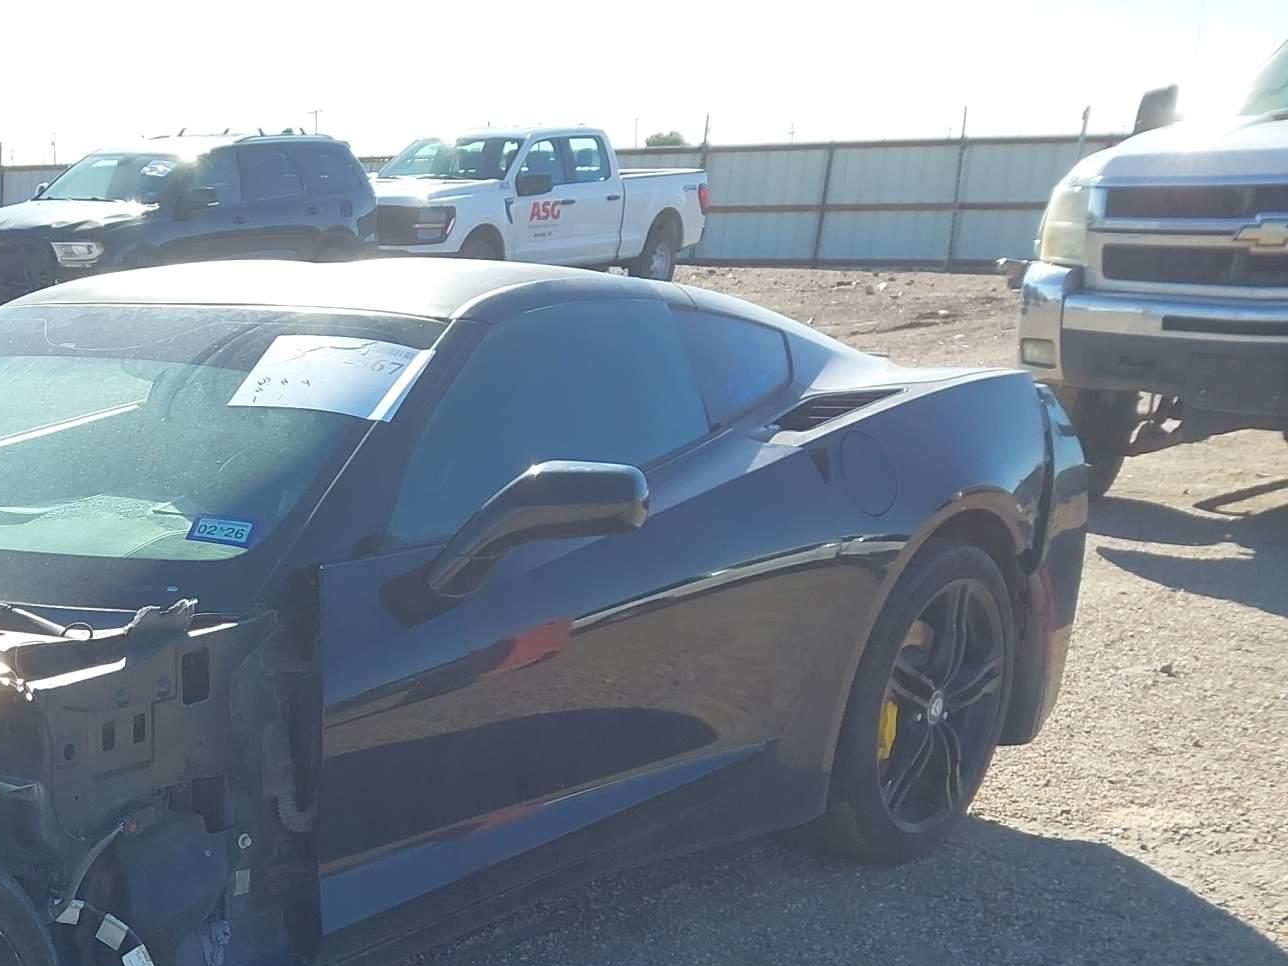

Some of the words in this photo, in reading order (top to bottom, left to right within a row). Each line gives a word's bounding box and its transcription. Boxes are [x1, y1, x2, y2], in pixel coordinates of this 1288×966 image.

[530, 200, 561, 221] ASG
[198, 525, 217, 536] 02
[224, 528, 245, 539] 26
